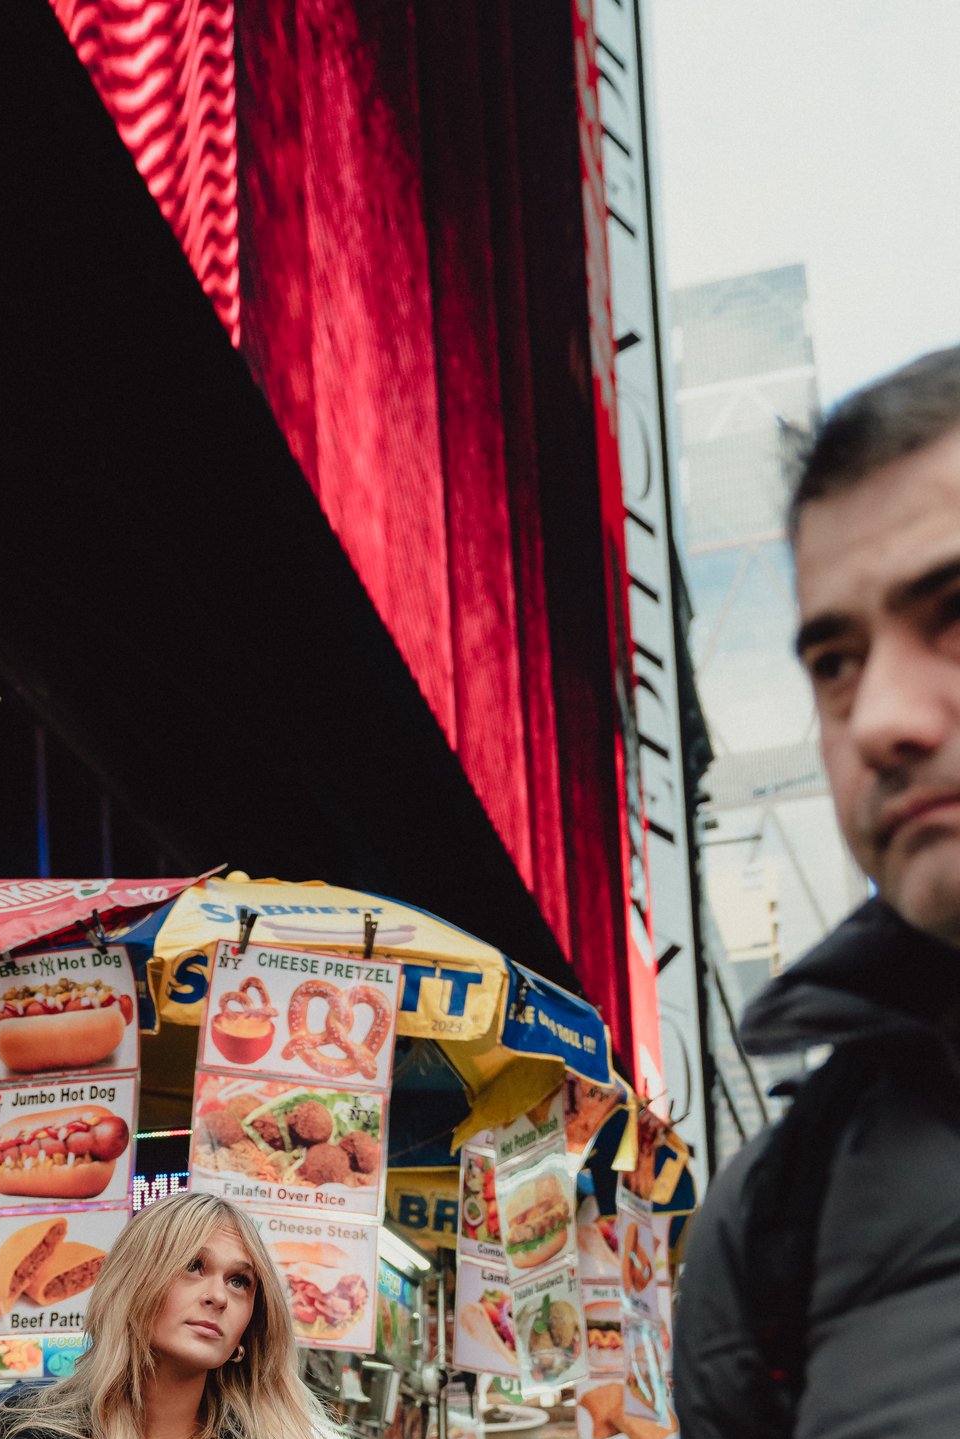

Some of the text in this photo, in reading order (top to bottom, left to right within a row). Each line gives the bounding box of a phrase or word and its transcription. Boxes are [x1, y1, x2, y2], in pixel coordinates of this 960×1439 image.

[223, 944, 230, 956] I
[58, 953, 86, 971] Hot
[92, 952, 122, 968] Dog
[218, 956, 242, 970] NY
[257, 952, 394, 984] CHEESE PRETZEL
[11, 1085, 116, 1107] Jumbo Hot Dog
[353, 1096, 360, 1108] I
[349, 1108, 376, 1123] NY
[223, 1183, 346, 1206] Falafel Over Rice
[268, 1219, 323, 1236] Cheese
[327, 1225, 369, 1241] Steak
[10, 1312, 45, 1329] Beef
